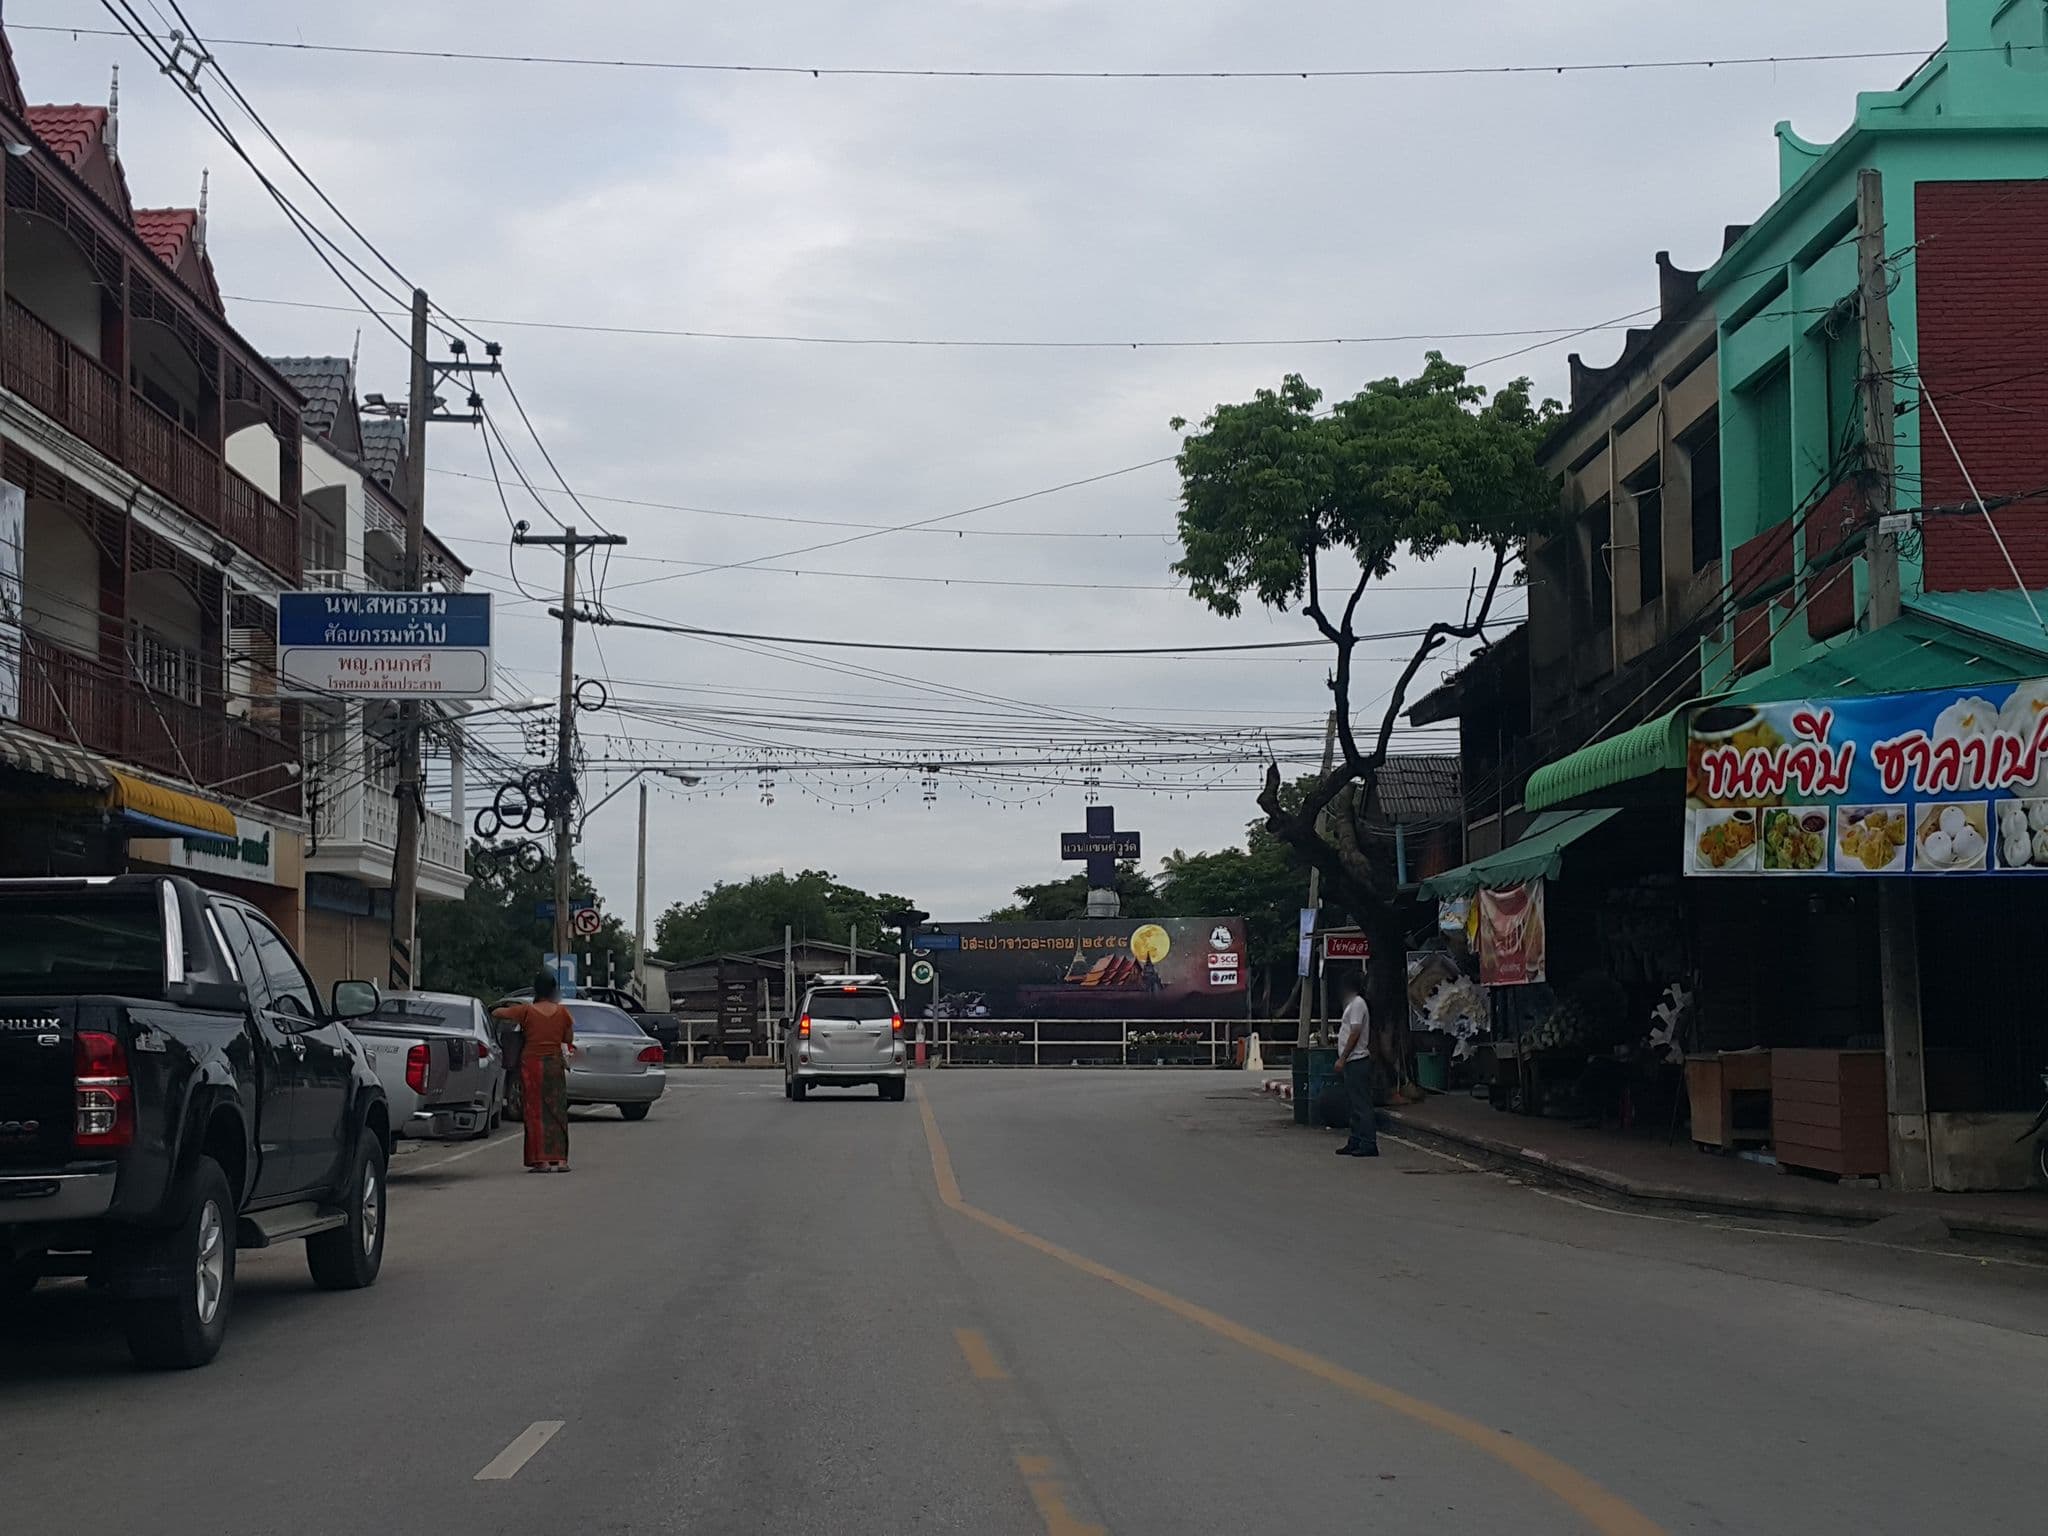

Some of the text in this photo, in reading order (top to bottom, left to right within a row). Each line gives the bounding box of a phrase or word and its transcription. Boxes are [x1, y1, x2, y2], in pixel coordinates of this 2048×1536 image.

[325, 618, 447, 643] ศัลยกรรมทั่วไป
[338, 653, 432, 674] พญ.กนกศรี
[1704, 711, 1853, 796] ขนมจีบ
[1220, 955, 1238, 965] SCG
[1220, 973, 1236, 982] ptt
[0, 1018, 61, 1030] HILUX
